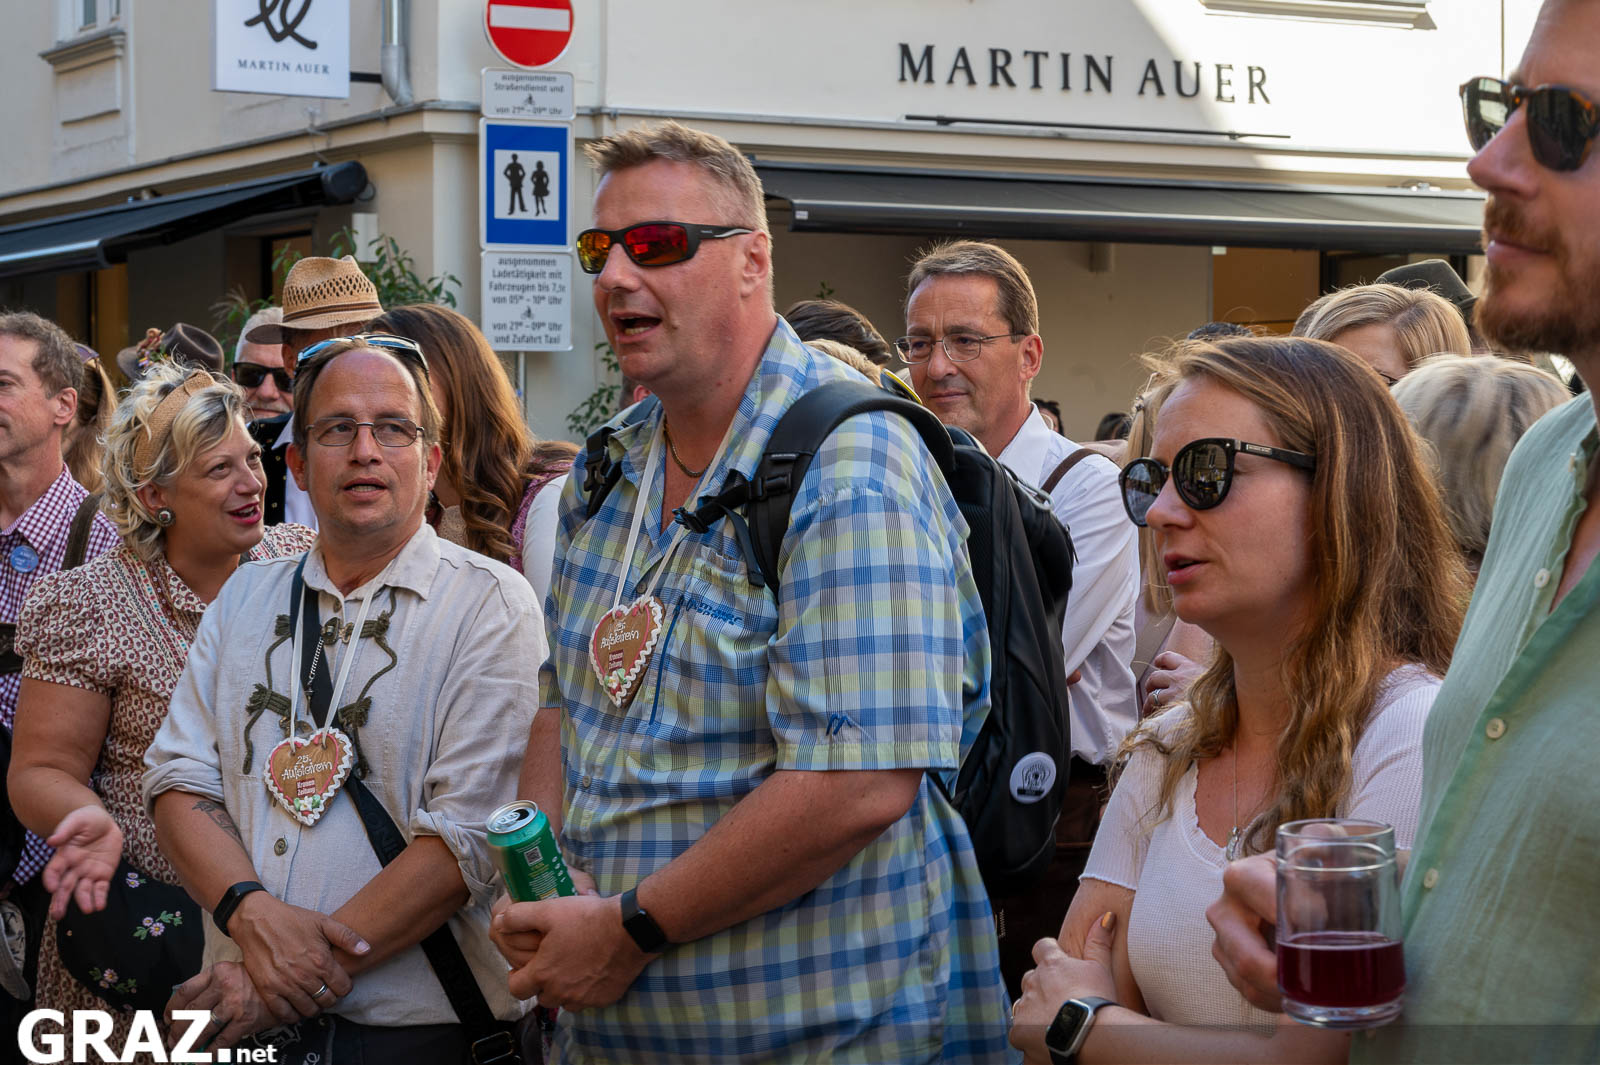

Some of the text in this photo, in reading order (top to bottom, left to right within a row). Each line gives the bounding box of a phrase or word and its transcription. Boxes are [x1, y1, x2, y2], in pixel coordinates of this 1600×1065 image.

[238, 59, 330, 75] MARTIN AUER
[501, 73, 557, 82] ausgenommen
[897, 42, 1272, 105] MARTIN AUER
[549, 85, 565, 93] und
[498, 257, 557, 267] ausgenommen
[492, 269, 562, 280] Ladetätigkeit mit
[489, 281, 536, 293] Fahrzeugen
[537, 283, 550, 292] bis
[491, 296, 508, 304] von
[548, 295, 562, 305] Uhr
[492, 322, 508, 330] von
[548, 322, 562, 331] Uhr
[494, 334, 561, 344] und Zufahrt Taxi
